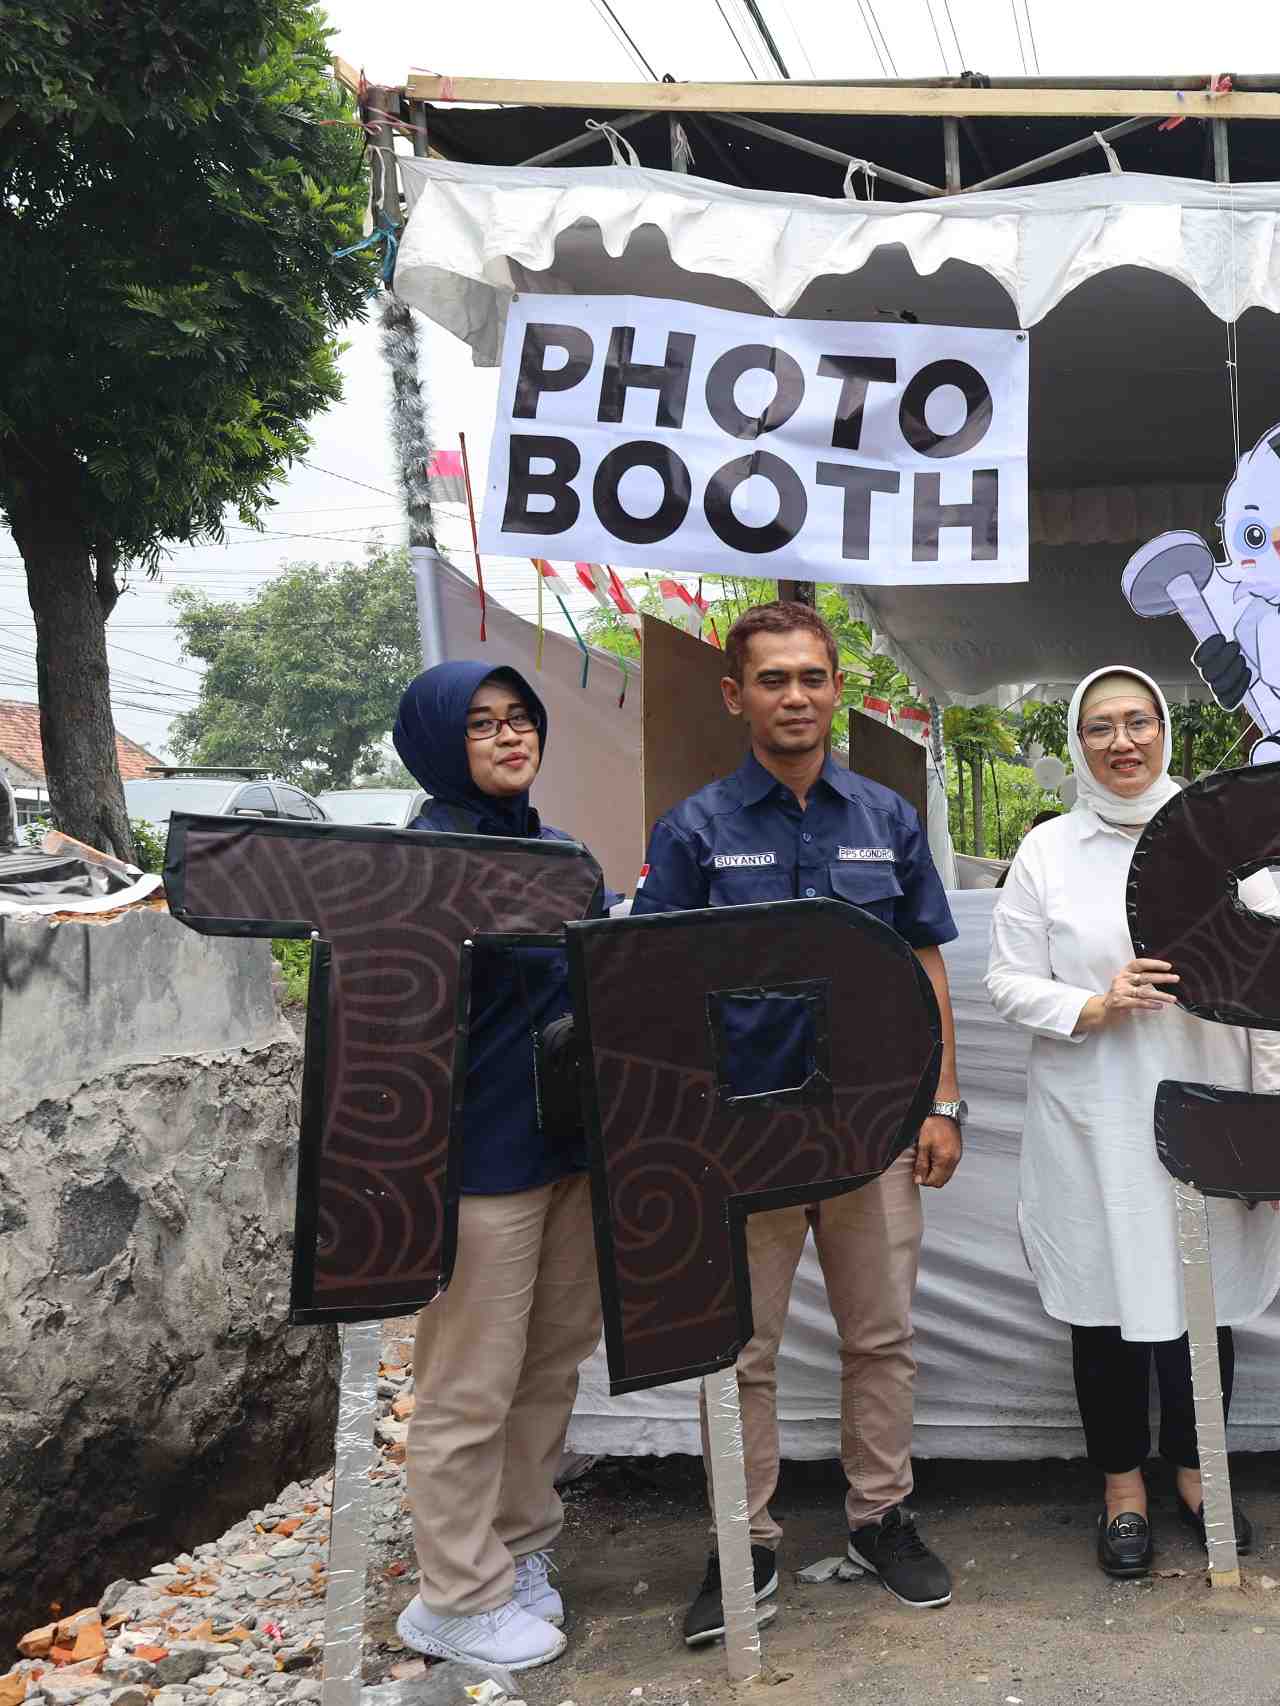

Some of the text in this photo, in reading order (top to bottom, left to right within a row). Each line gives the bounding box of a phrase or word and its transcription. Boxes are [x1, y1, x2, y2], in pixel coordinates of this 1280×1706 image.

[512, 322, 994, 459] PHOTO
[501, 433, 999, 562] BOOTH
[716, 853, 773, 867] SUYANTO
[840, 849, 857, 859] PPS
